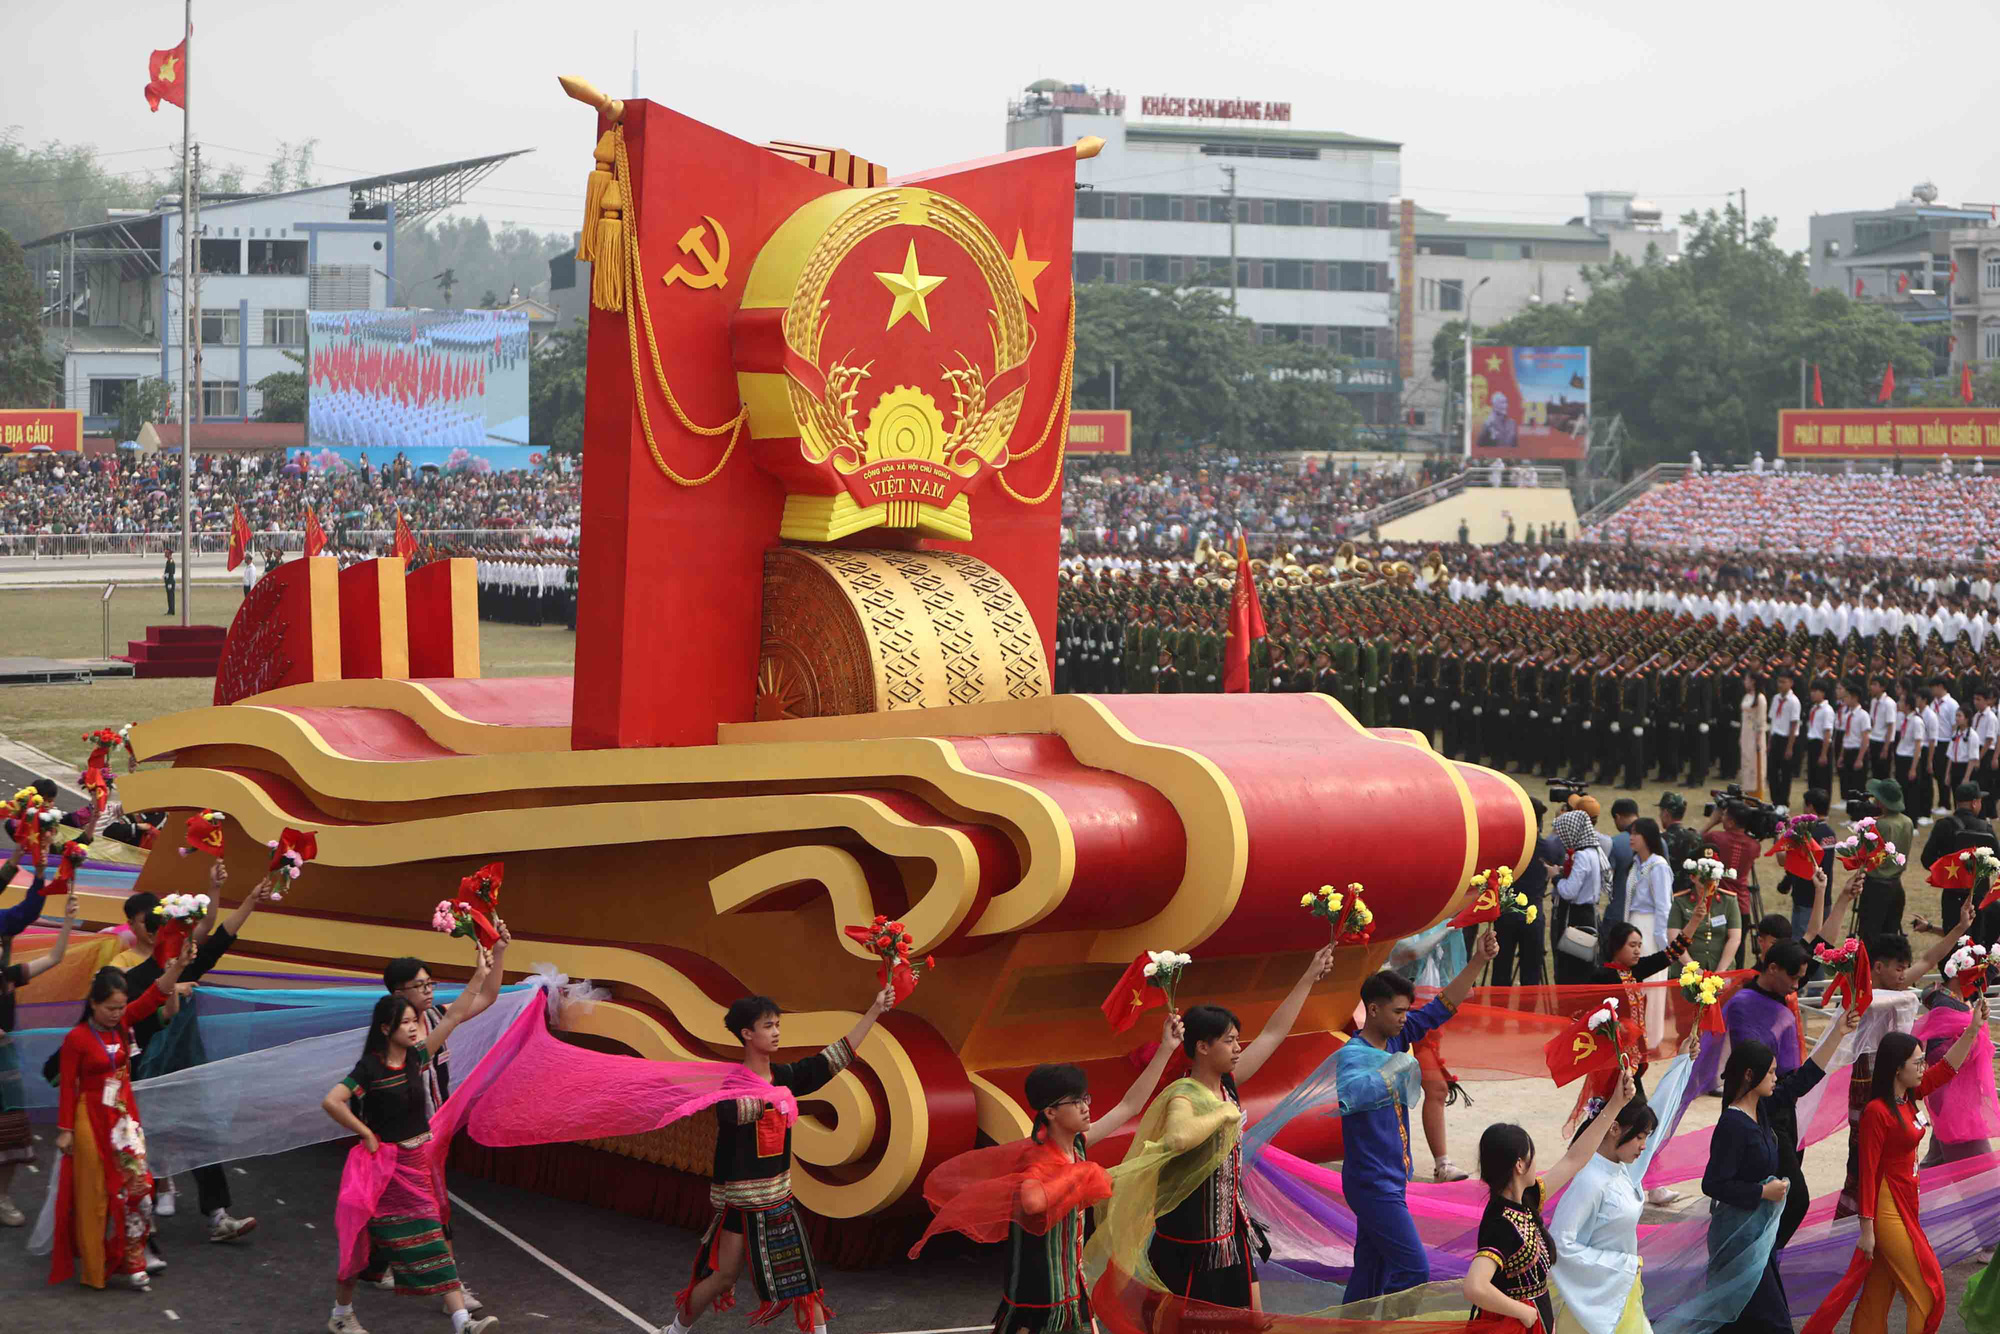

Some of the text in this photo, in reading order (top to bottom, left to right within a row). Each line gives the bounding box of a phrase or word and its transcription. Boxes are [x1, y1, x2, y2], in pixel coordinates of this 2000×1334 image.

[1142, 93, 1184, 116] KHÁCH
[1188, 98, 1215, 121] SẠN
[1264, 102, 1291, 121] ANH
[5, 424, 23, 447] ĐỊA
[864, 466, 881, 480] CỘNG
[908, 462, 919, 472] HỘI
[920, 462, 932, 474] CHỦ
[933, 469, 951, 481] NGHĨA
[869, 475, 946, 499] VIỆT NAM
